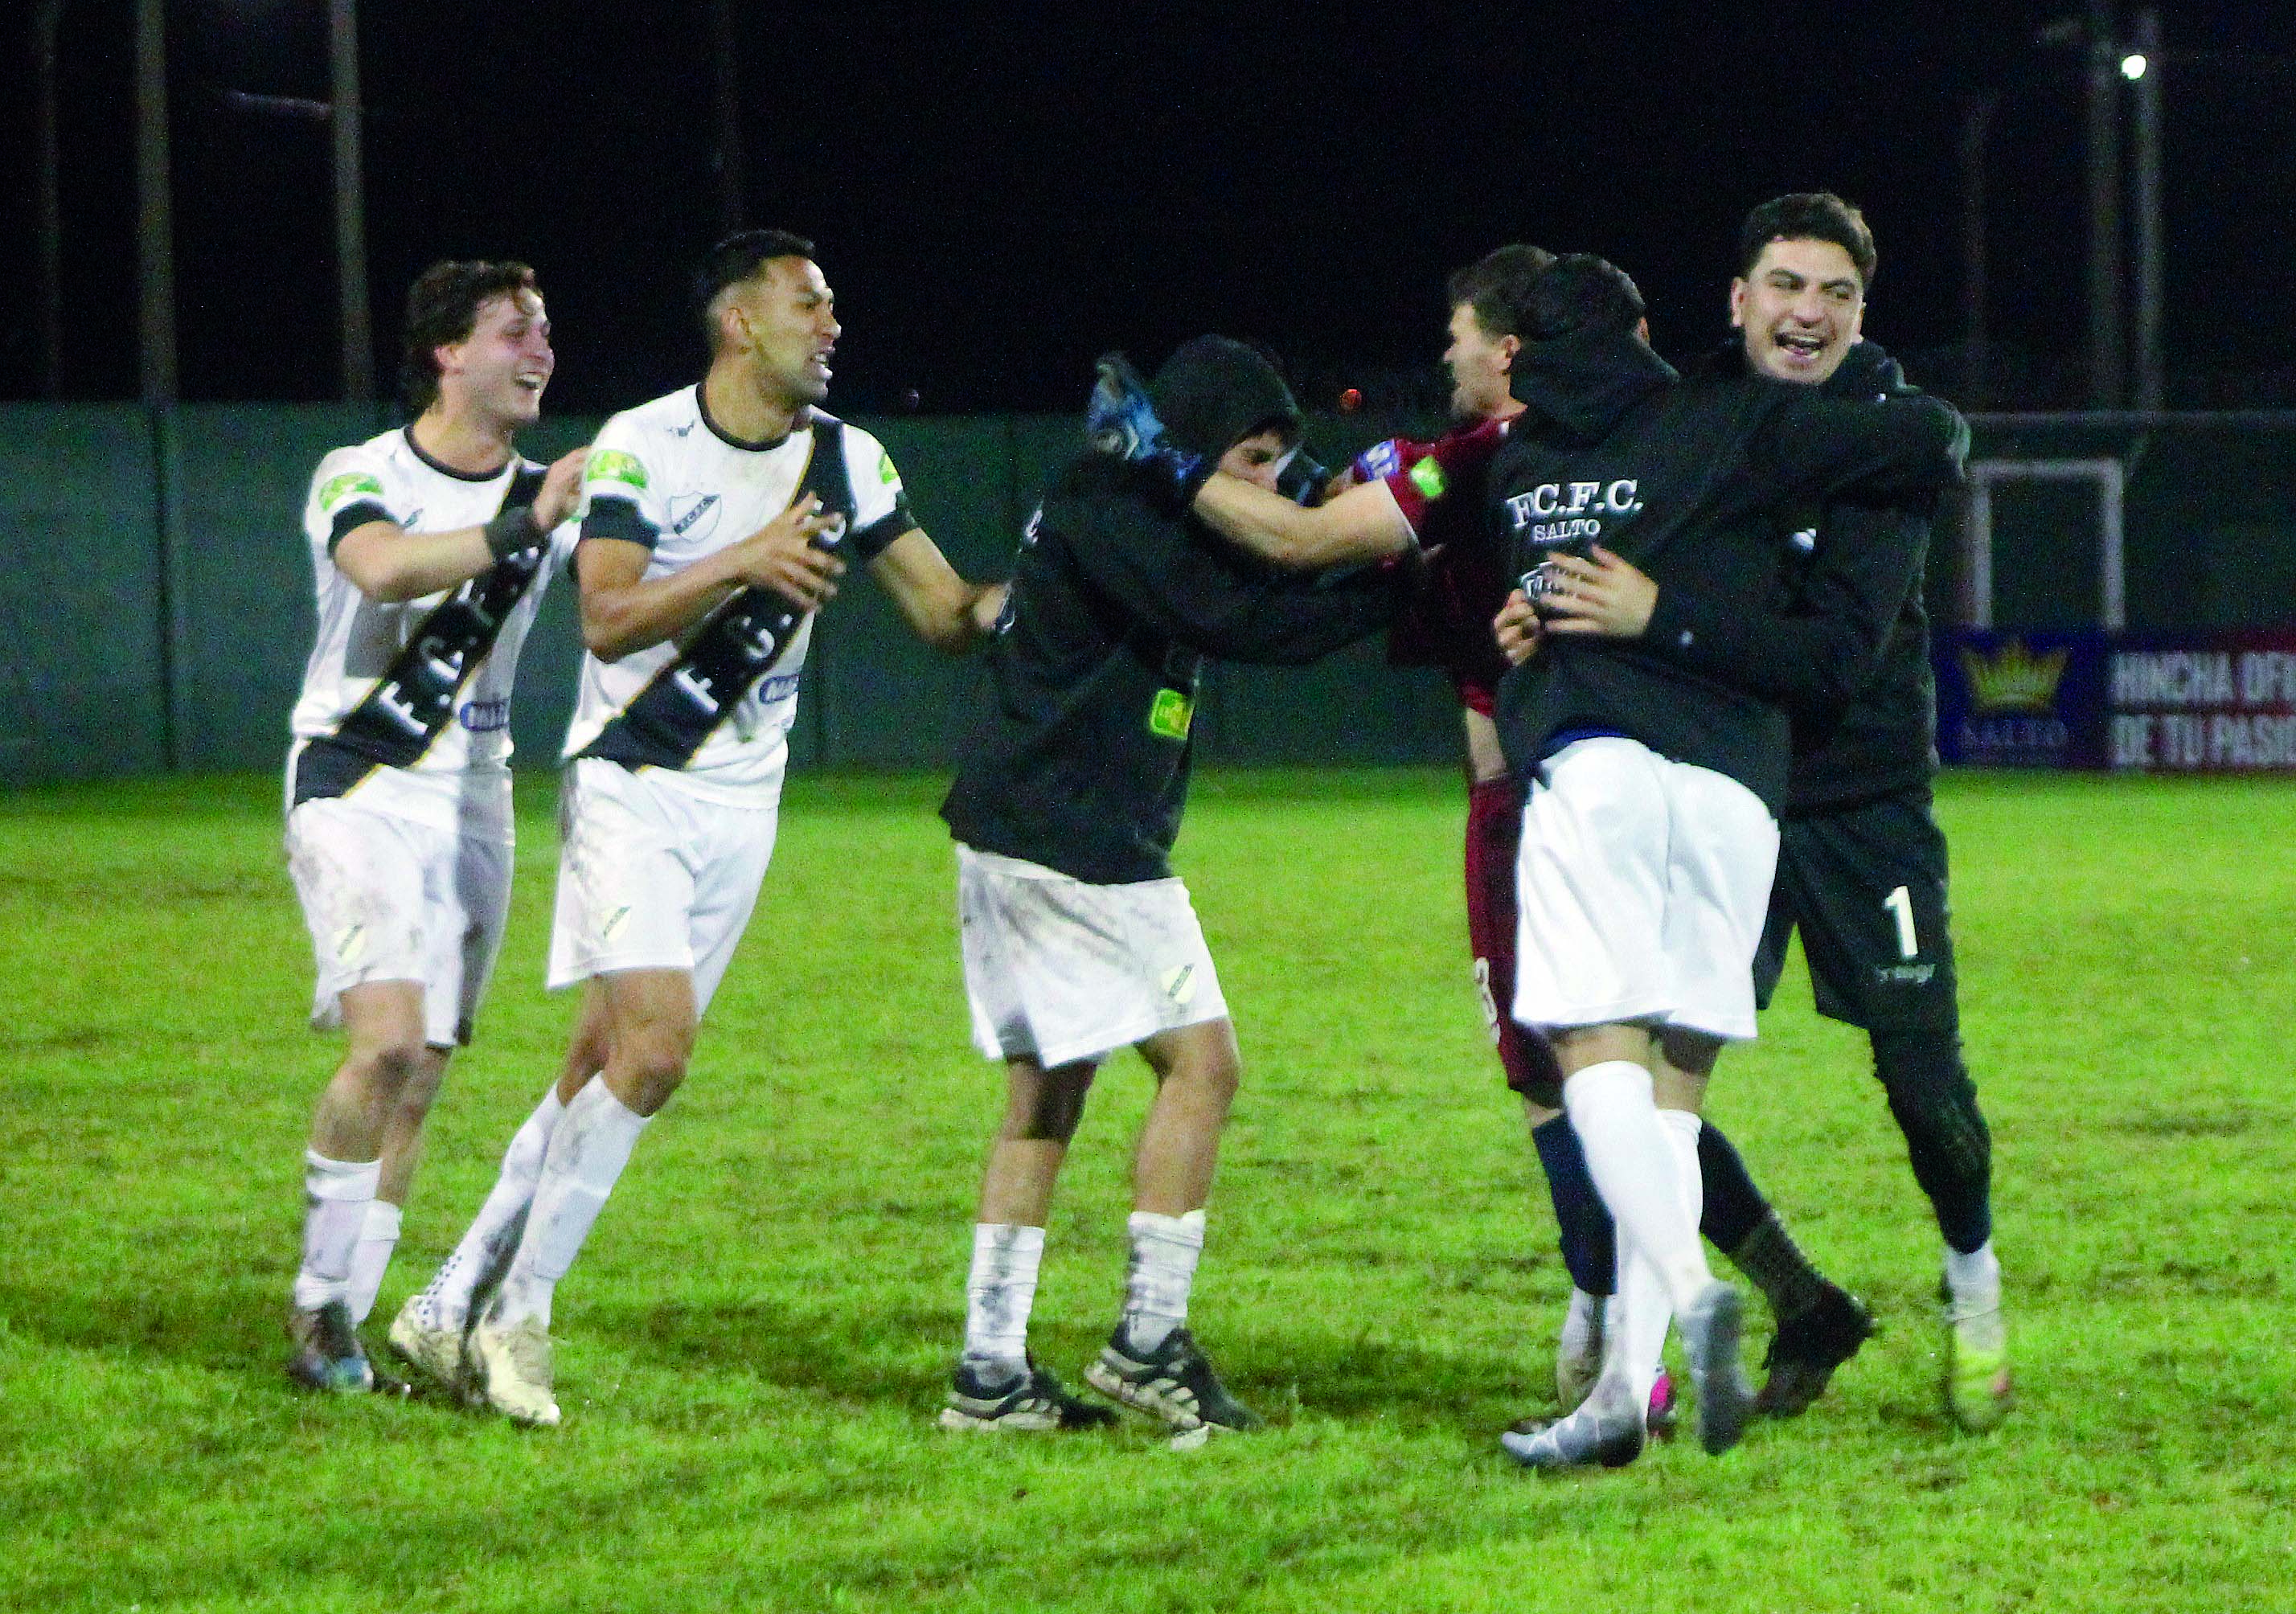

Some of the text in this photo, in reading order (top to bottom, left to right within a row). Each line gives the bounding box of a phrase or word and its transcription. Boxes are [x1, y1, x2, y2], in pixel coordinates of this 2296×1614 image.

[1534, 518, 1601, 542] SALTO
[2112, 651, 2232, 703] HINCHA
[2112, 715, 2155, 765] DE
[2165, 715, 2202, 765] TU
[1884, 884, 1919, 958] 1
